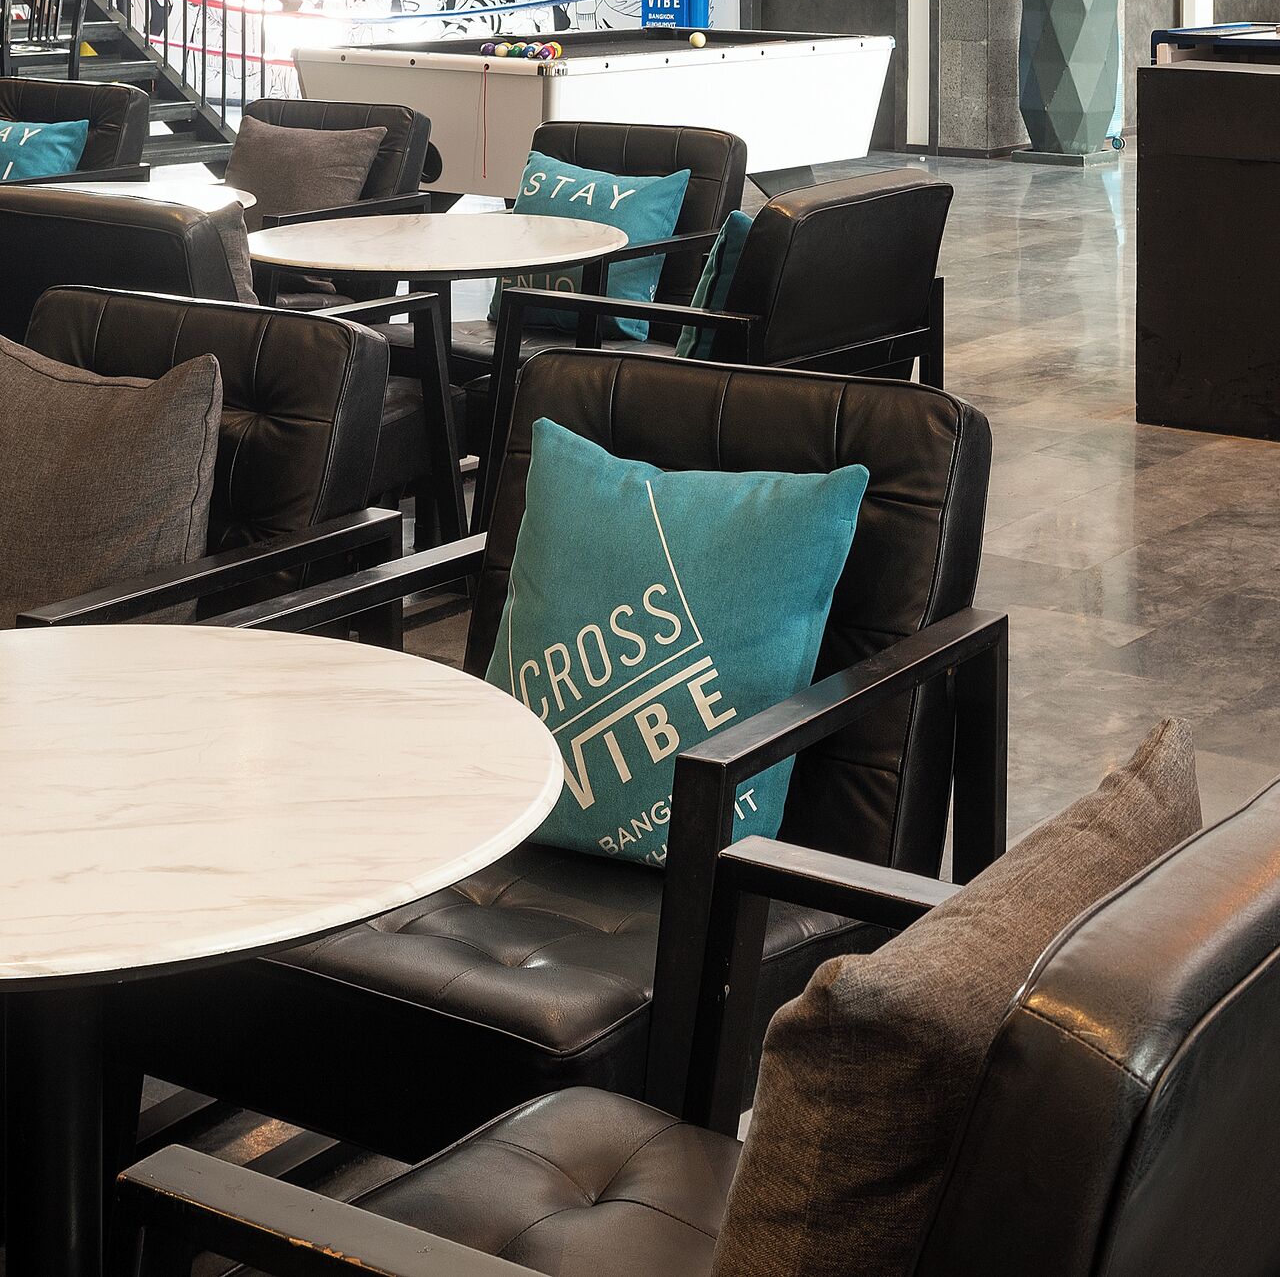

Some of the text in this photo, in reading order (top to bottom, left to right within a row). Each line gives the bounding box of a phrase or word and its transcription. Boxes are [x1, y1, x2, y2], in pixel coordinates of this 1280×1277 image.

[523, 172, 636, 211] STAY
[519, 583, 682, 722] CROSS
[563, 655, 738, 810] VIBE
